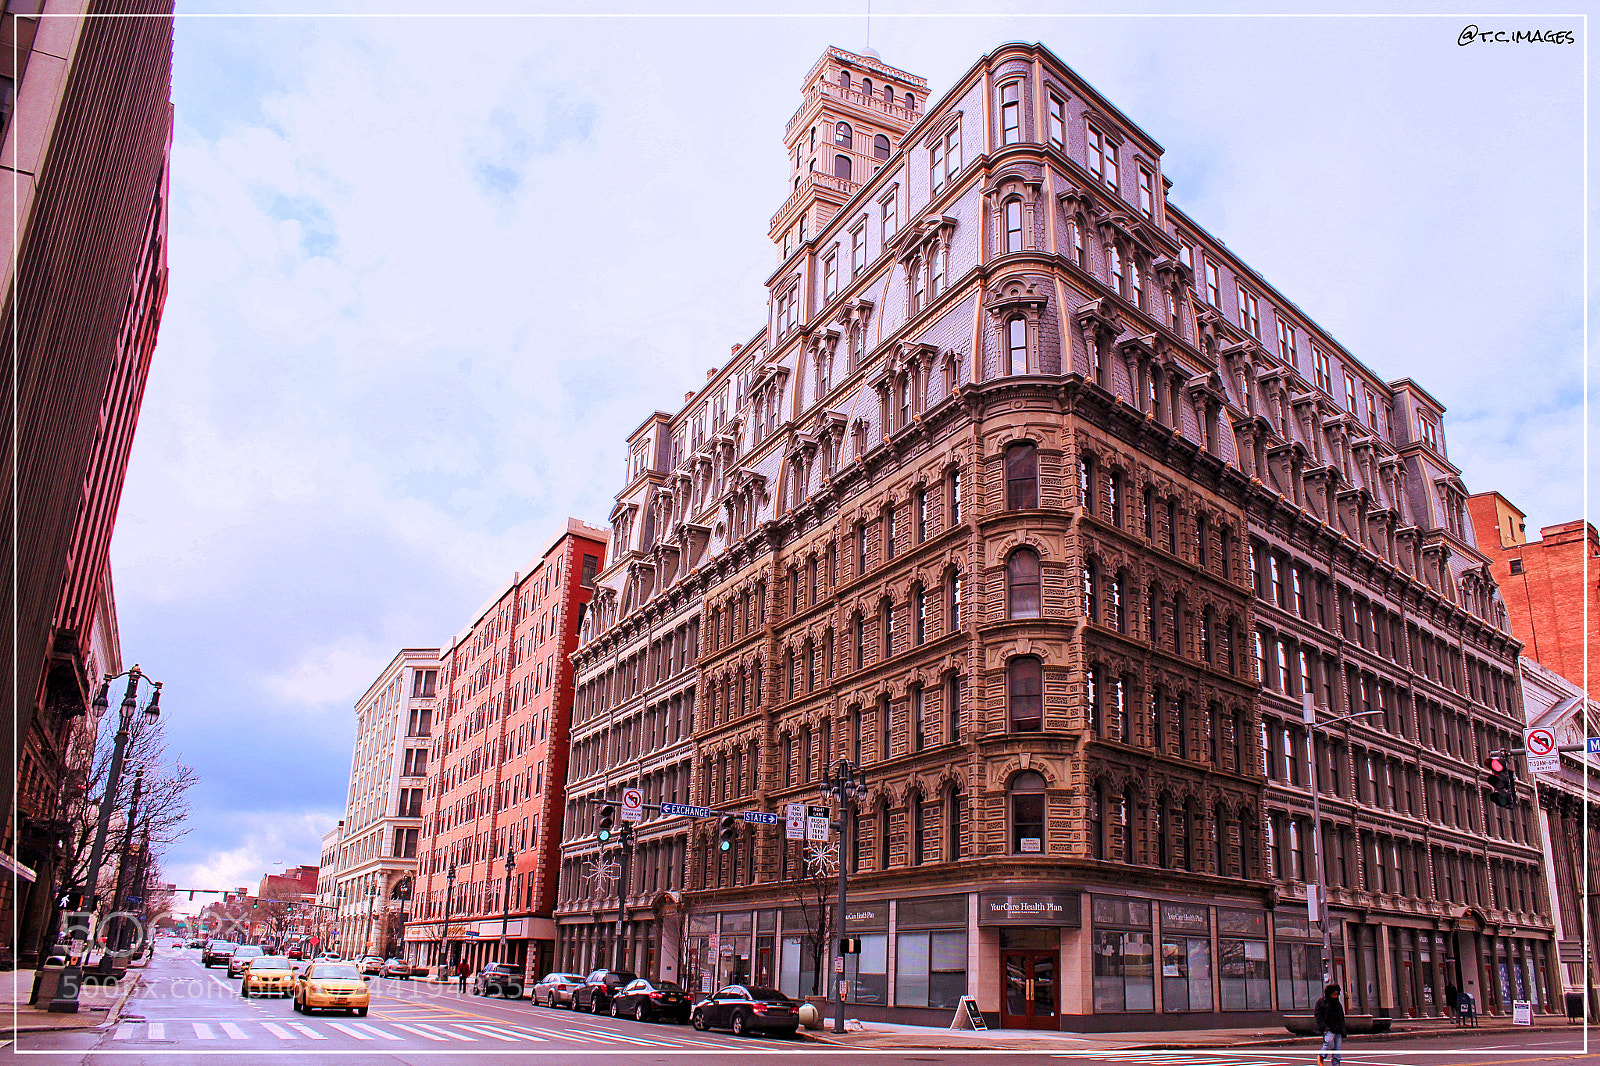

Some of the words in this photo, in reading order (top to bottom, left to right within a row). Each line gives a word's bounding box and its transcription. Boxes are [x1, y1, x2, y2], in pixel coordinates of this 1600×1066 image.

[671, 805, 709, 817] EXCHANGE
[745, 812, 768, 823] STATE
[990, 902, 1020, 911] YourCare
[1020, 902, 1046, 911] Health
[1046, 902, 1063, 912] Plan
